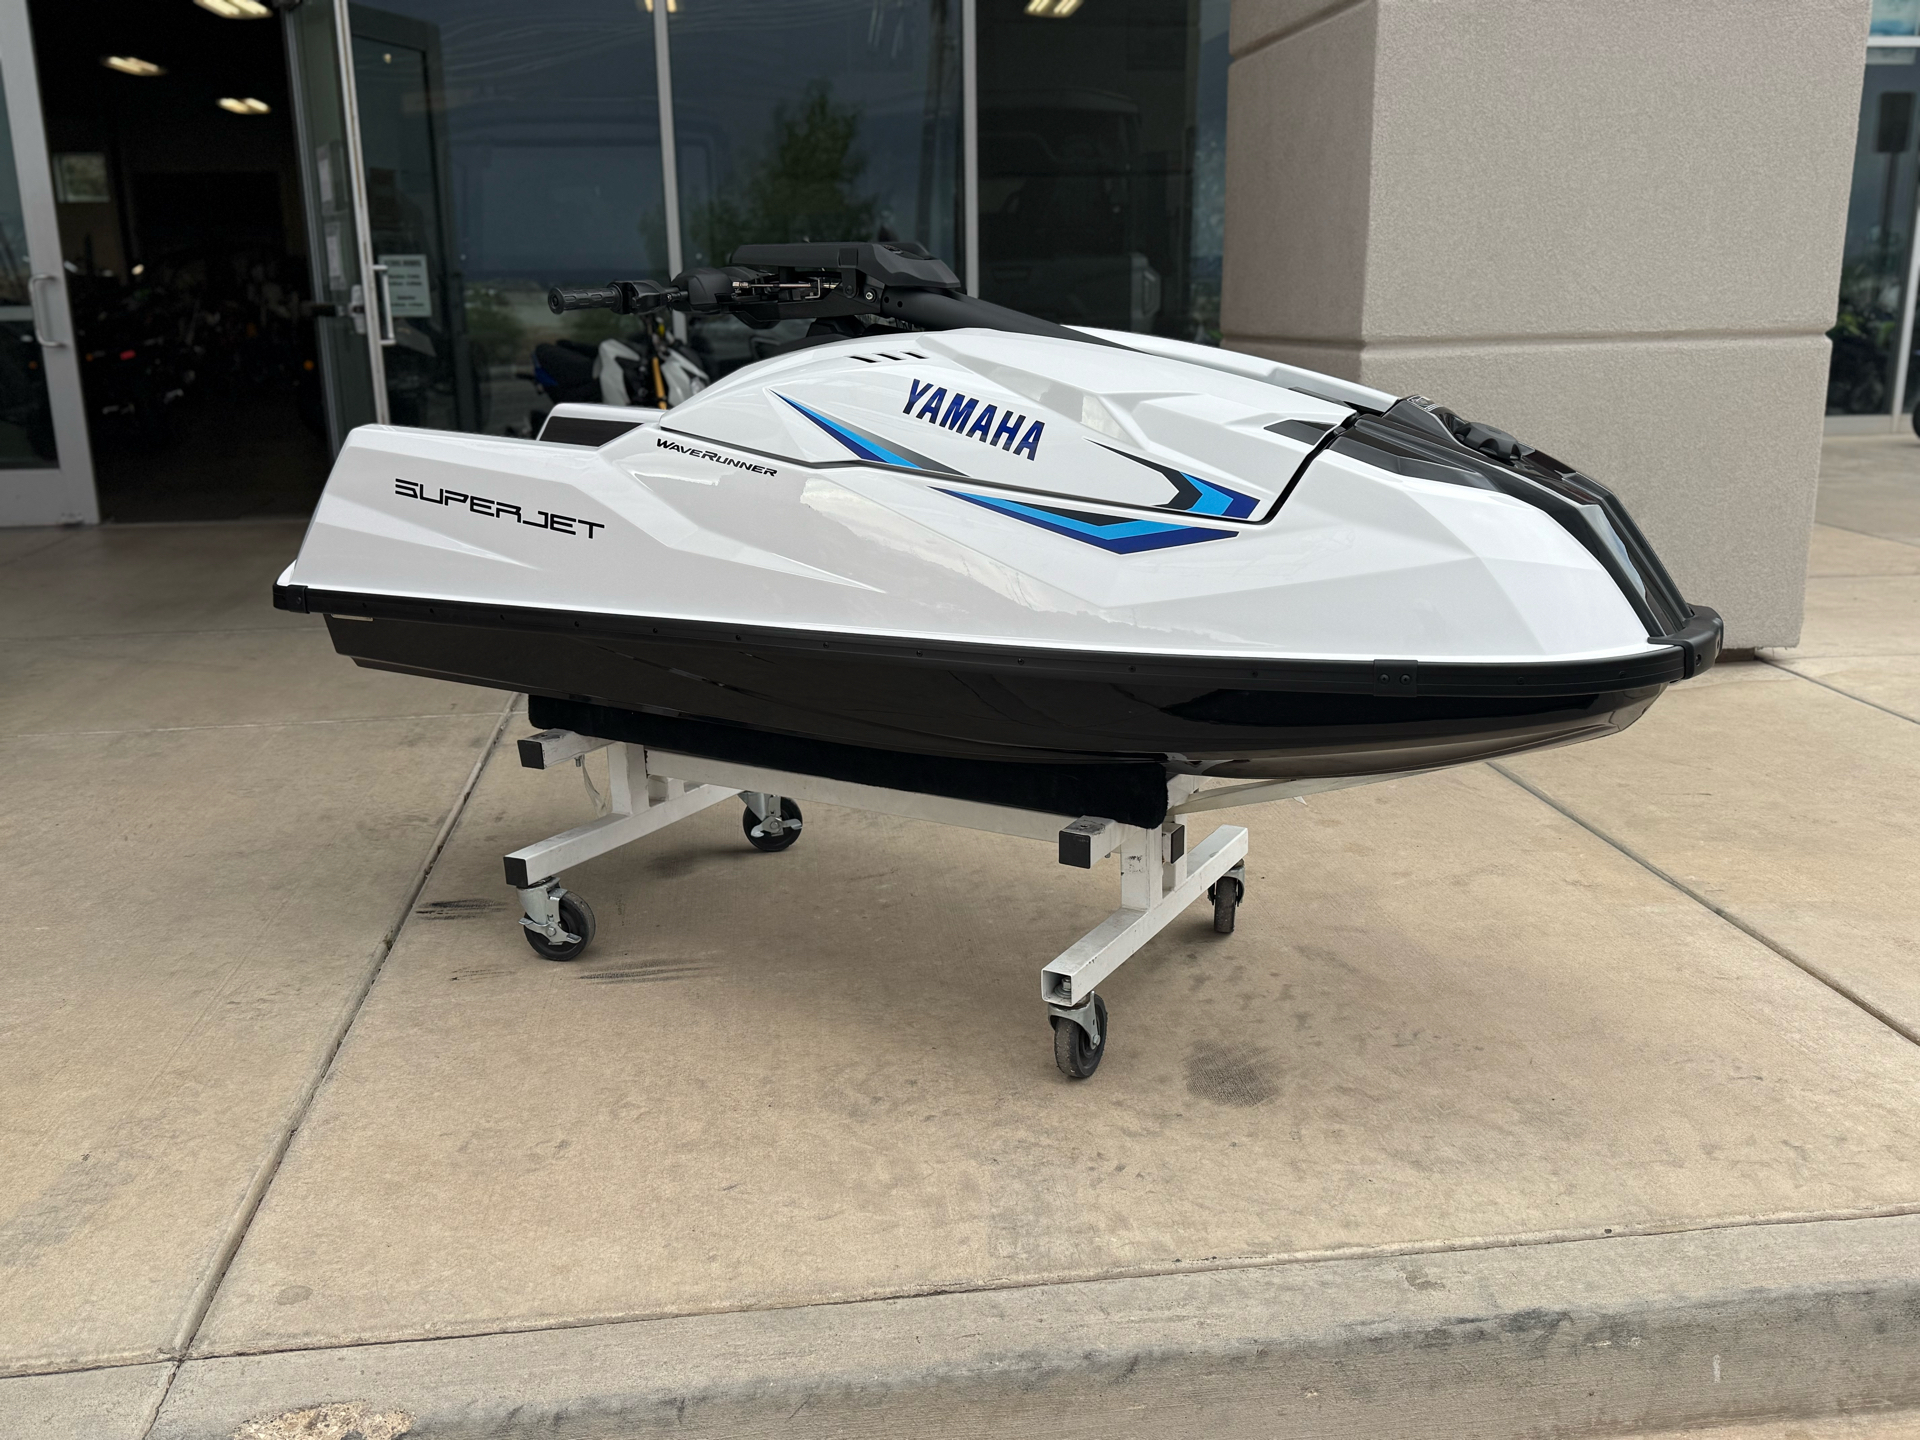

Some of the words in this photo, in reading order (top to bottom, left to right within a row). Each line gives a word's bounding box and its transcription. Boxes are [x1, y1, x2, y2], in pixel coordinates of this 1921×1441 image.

[902, 378, 1046, 462] YAMAHA
[656, 438, 778, 477] WAVERUNNER
[394, 478, 605, 540] SUPERJET
